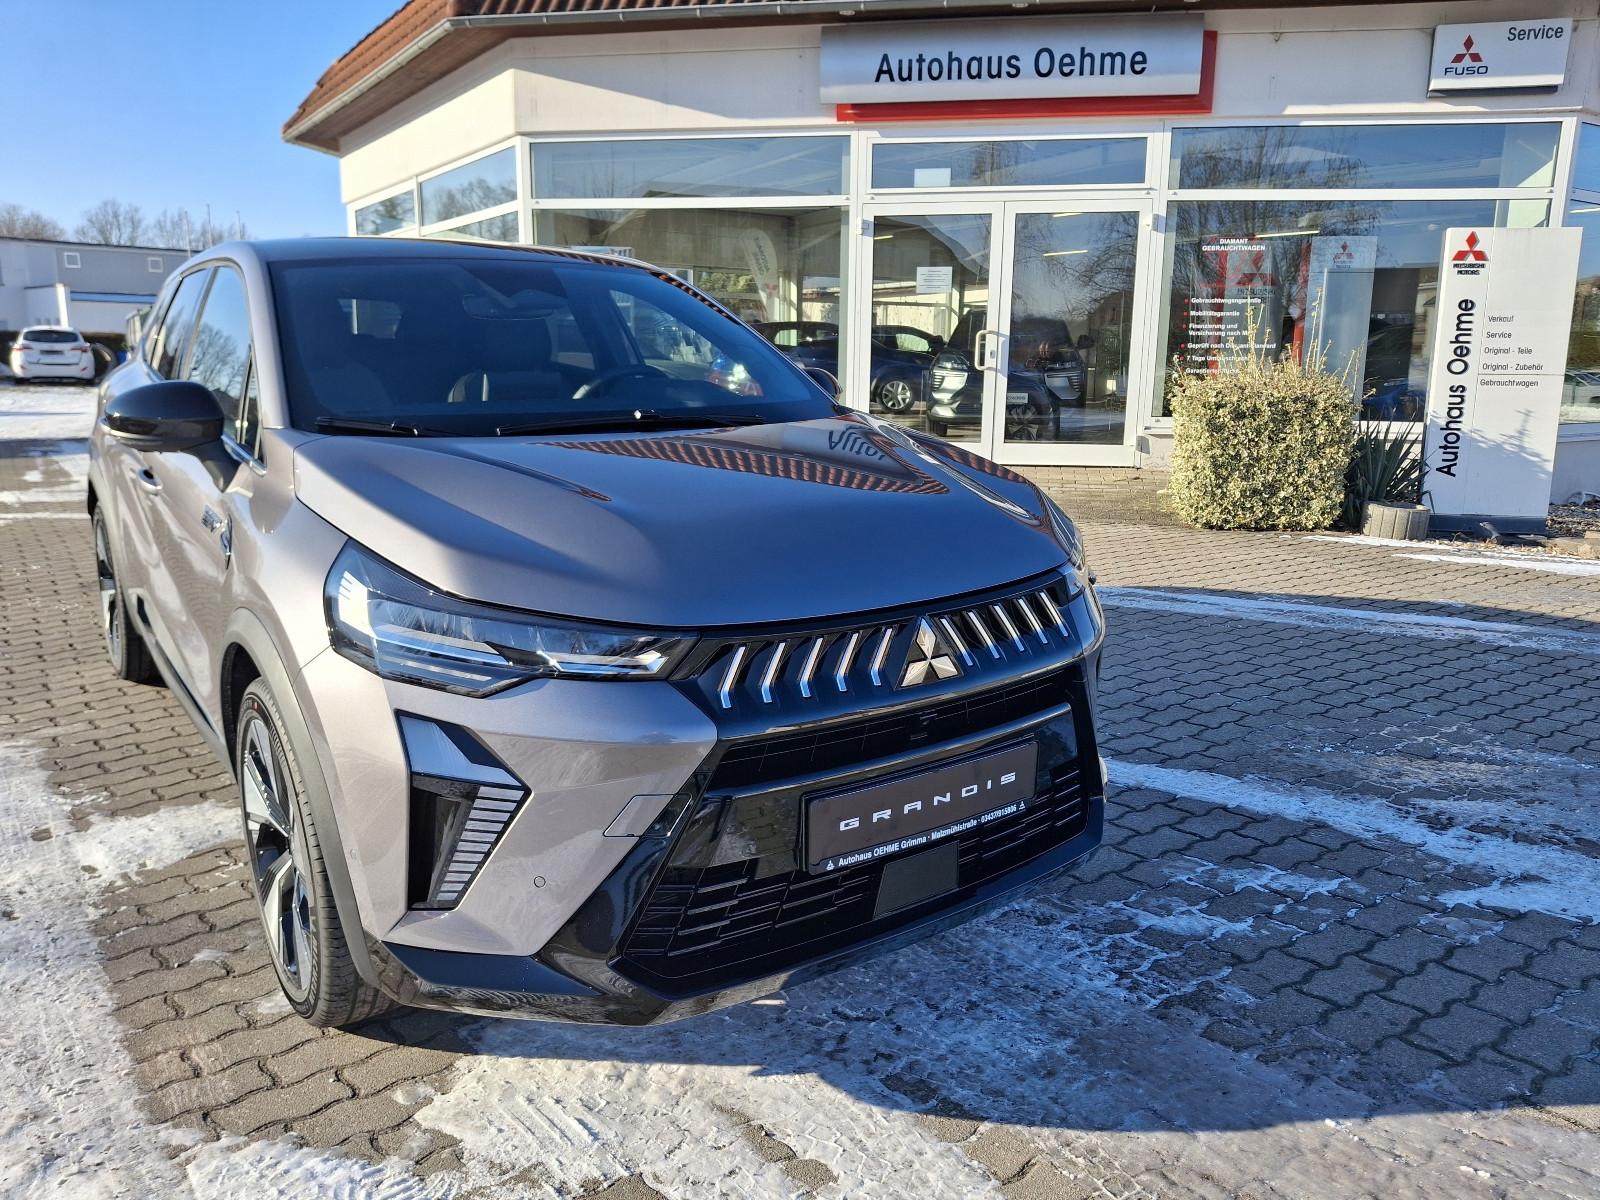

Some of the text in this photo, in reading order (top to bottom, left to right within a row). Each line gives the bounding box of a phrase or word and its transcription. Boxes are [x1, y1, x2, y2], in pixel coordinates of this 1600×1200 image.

[1507, 25, 1563, 41] Service
[874, 47, 1148, 82] Autohaus Oehme
[1444, 65, 1489, 76] FUSO
[1488, 315, 1514, 323] Verkauf
[1486, 331, 1512, 339] Service
[1484, 347, 1511, 355] Original
[1482, 363, 1509, 371] Original
[1515, 363, 1544, 371] Zubehör
[1435, 299, 1476, 477] Autohaus Oehme
[1480, 379, 1539, 388] Gebrauchtwagen
[839, 772, 1016, 832] GRANDIS
[838, 851, 872, 867] Autohaus
[873, 842, 900, 857] OEHME
[900, 836, 927, 849] Grimma
